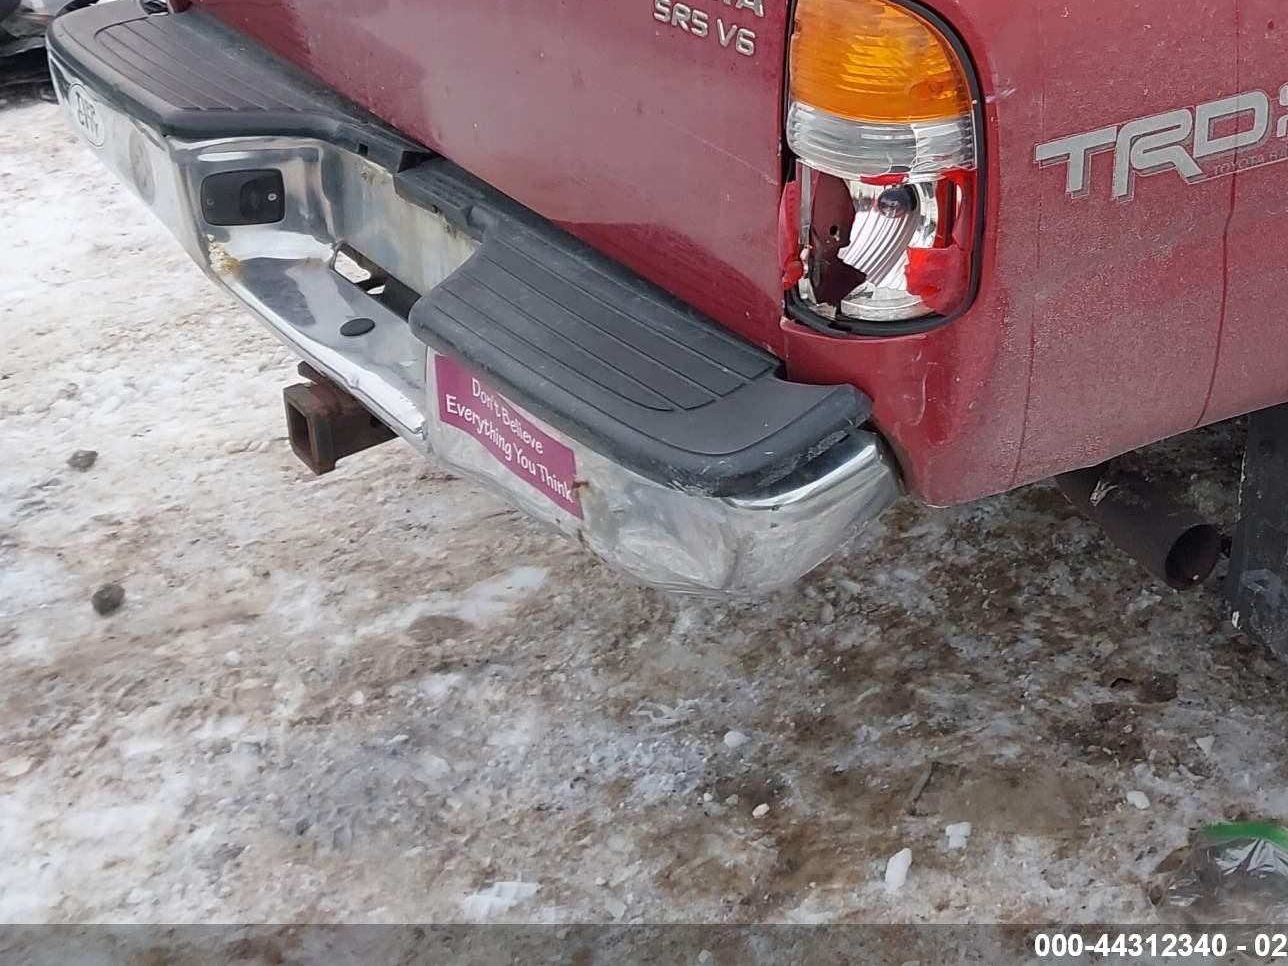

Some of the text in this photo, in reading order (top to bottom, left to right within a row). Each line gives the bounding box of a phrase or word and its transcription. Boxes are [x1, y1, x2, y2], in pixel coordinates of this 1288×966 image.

[716, 18, 756, 56] V6
[1034, 90, 1270, 202] TRD
[1214, 153, 1265, 176] TOYOTA
[445, 394, 574, 503] Everything You Think
[471, 377, 544, 454] Don't Believe
